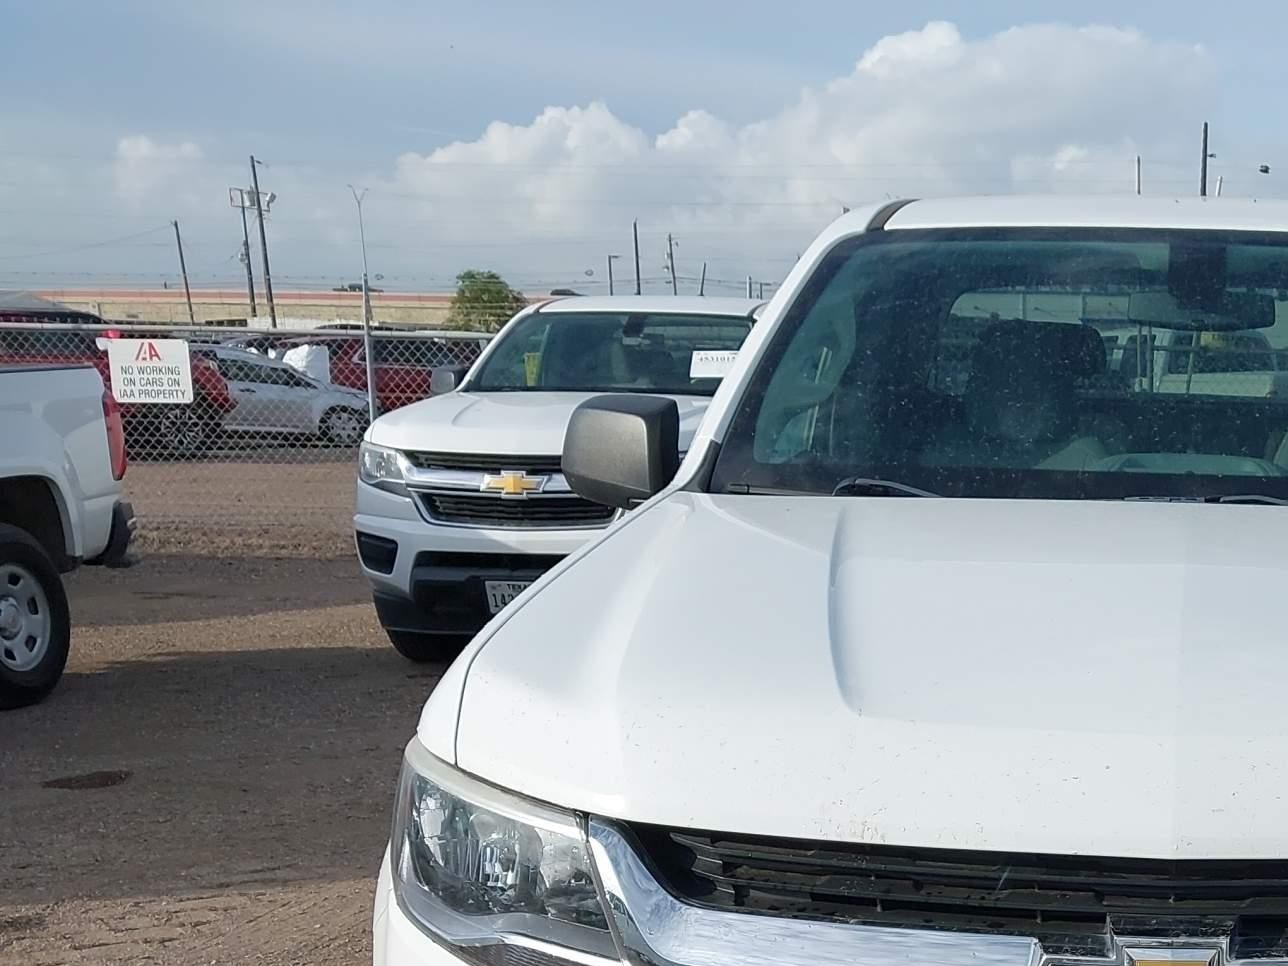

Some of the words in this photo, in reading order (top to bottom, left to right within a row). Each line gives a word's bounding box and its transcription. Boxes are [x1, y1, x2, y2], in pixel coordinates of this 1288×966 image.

[120, 366, 133, 375] NO
[137, 366, 181, 376] WORKING
[122, 378, 136, 387] ON
[139, 378, 164, 388] CARS
[166, 378, 180, 388] ON
[119, 389, 136, 399] IAA
[138, 389, 186, 399] PROPERTY
